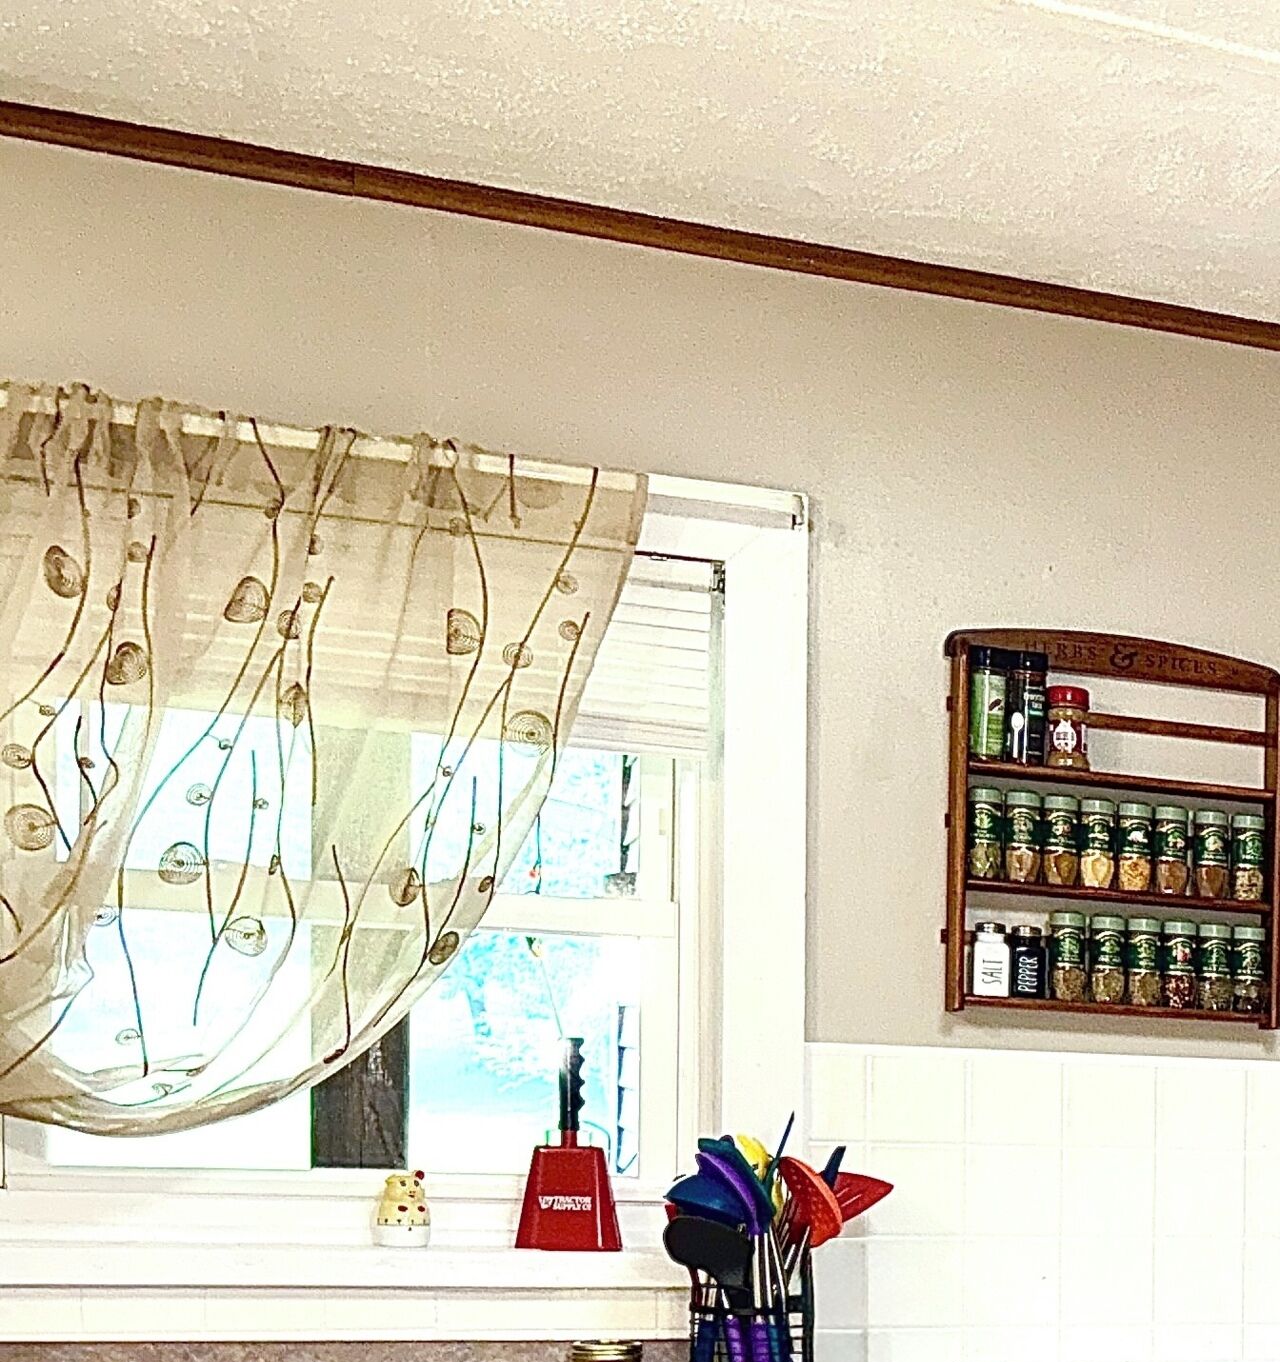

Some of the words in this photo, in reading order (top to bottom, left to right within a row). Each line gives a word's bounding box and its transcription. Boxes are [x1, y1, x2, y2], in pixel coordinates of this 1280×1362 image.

[1109, 643, 1138, 671] &
[1143, 652, 1218, 675] SPICES
[981, 957, 1003, 985] SALT
[1017, 956, 1039, 993] PEPPER
